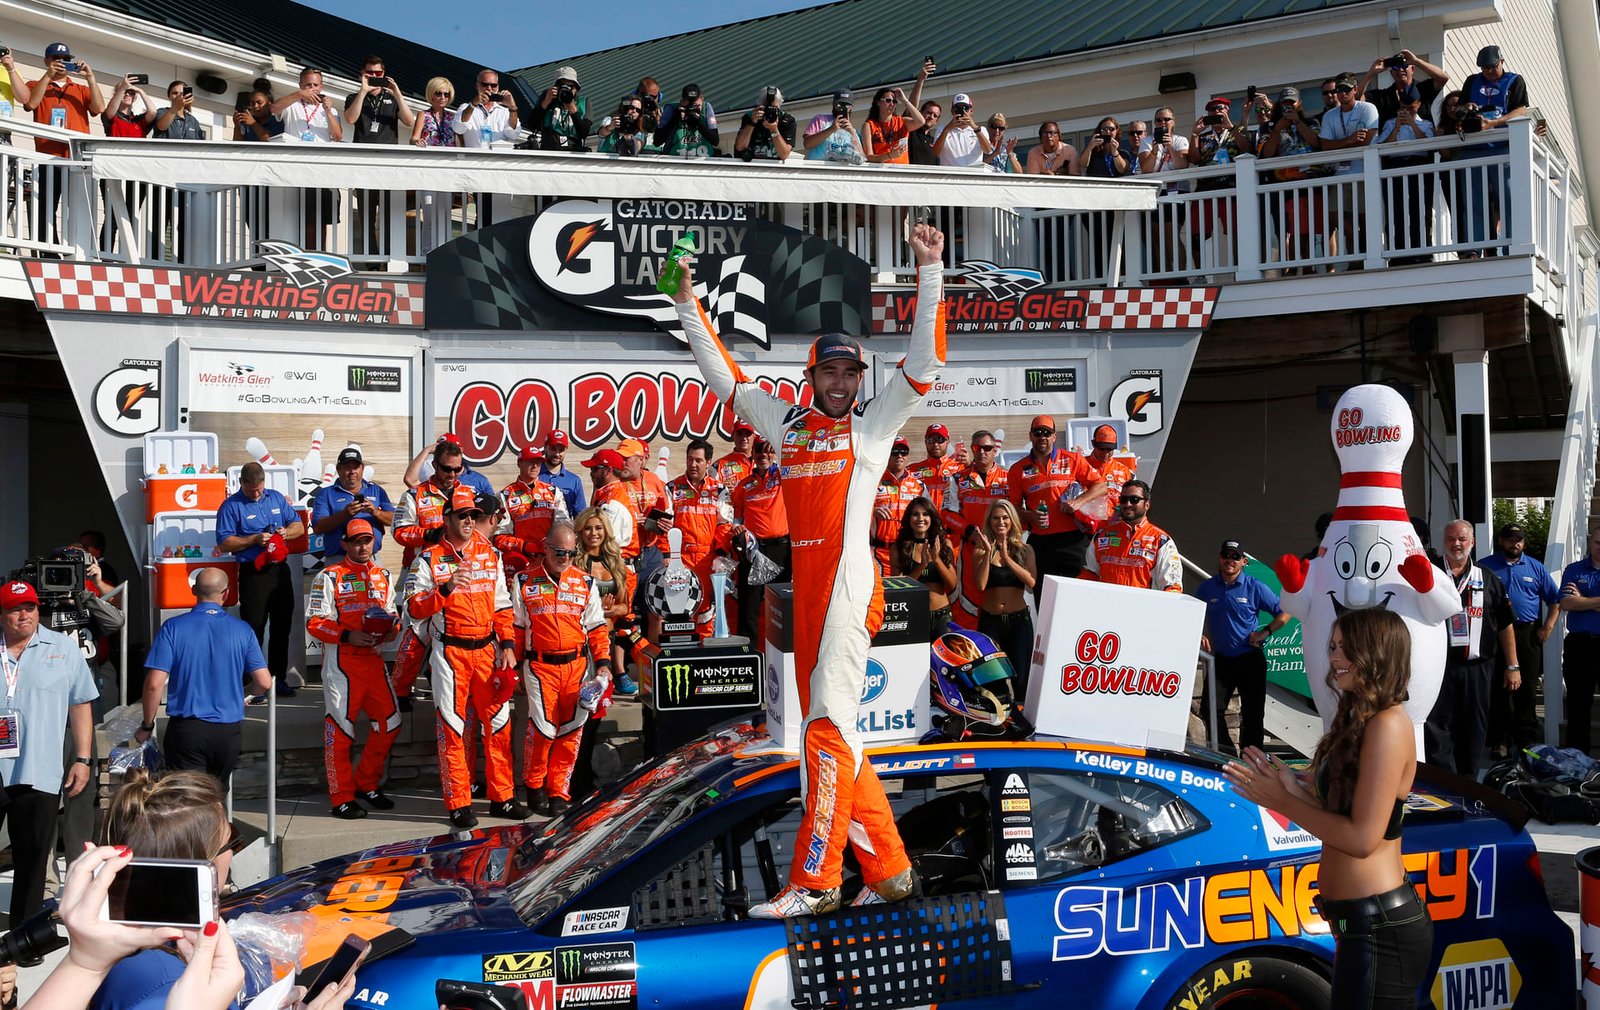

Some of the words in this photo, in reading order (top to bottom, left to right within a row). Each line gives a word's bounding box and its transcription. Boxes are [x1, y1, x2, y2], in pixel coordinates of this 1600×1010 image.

[617, 200, 747, 220] GATORADE
[529, 199, 615, 296] G
[620, 256, 699, 285] LAE
[183, 275, 319, 309] Watkins
[326, 283, 394, 312] Glen
[186, 306, 389, 323] INTERNATIONAL
[896, 296, 1015, 320] Wtkins
[1022, 293, 1088, 319] Glen
[199, 372, 244, 385] Watkins
[247, 375, 271, 385] Glen
[284, 371, 317, 381] @WGI
[967, 377, 997, 386] @WGI
[450, 379, 560, 466] GO
[1339, 407, 1363, 429] GO
[1336, 426, 1402, 448] BOWLING
[1263, 623, 1302, 648] reat
[1075, 630, 1121, 664] GO
[1268, 648, 1287, 656] NEW
[1290, 647, 1304, 655] YO
[694, 666, 754, 678] MONSTER
[1060, 663, 1181, 698] BOWLING
[1075, 751, 1132, 775] Kelley
[1135, 761, 1176, 782] Blue
[1181, 770, 1226, 792] Book
[804, 750, 833, 876] SUNENERGY1
[1005, 843, 1034, 857] MAC
[1052, 843, 1497, 962] SUNENEY1
[572, 922, 596, 933] RACE
[598, 921, 617, 929] CAR
[585, 910, 620, 923] NASCAR
[583, 950, 631, 961] MONSTER
[485, 972, 527, 982] MECHANIX
[529, 969, 553, 978] WEAR
[1445, 963, 1509, 1010] NAPA
[561, 984, 631, 1008] FLOWMASTER
